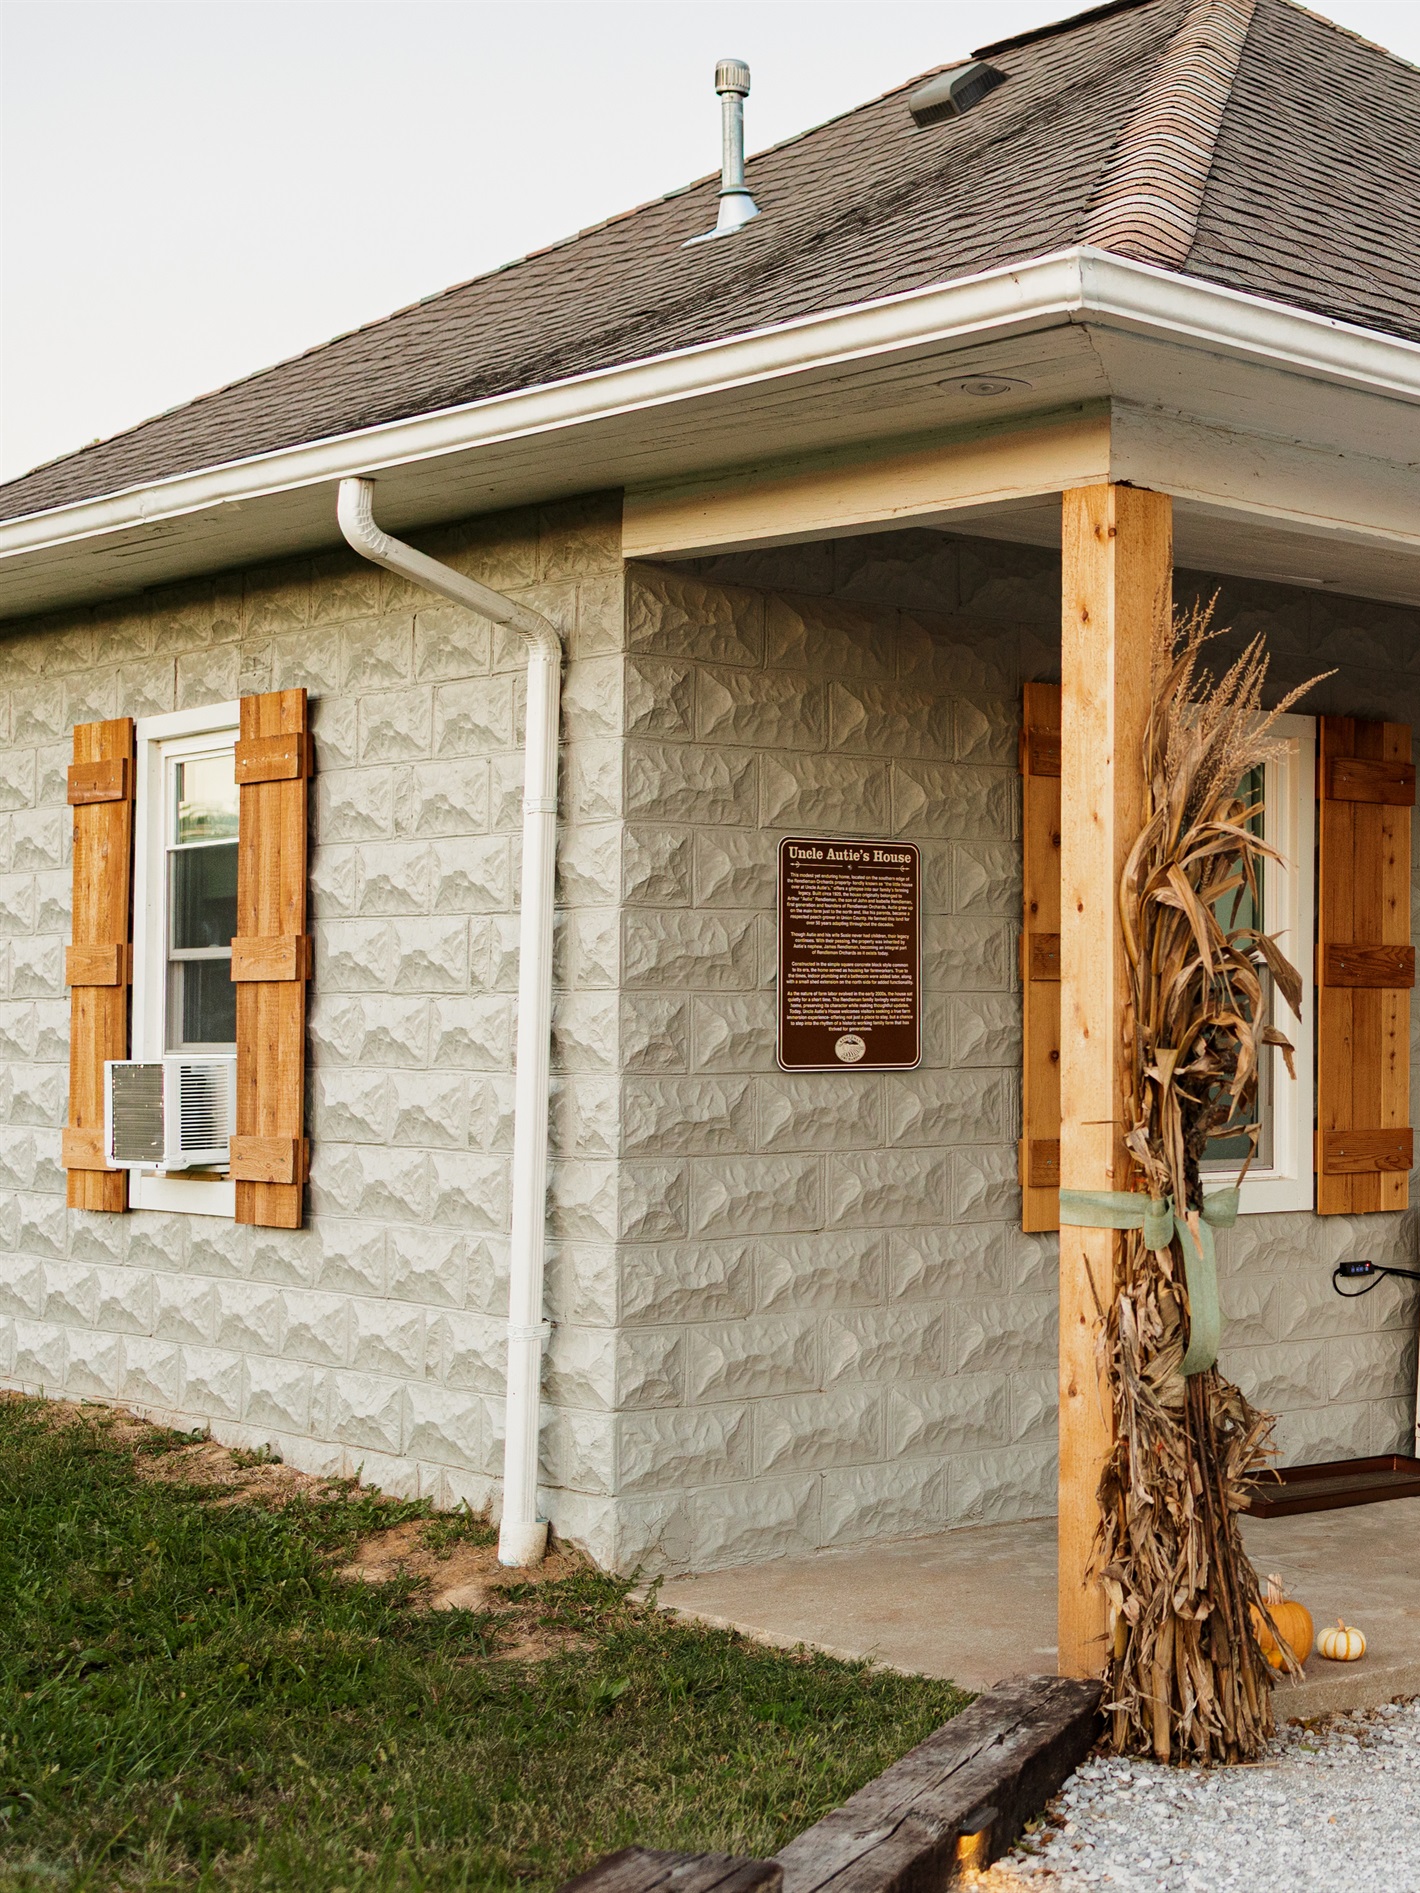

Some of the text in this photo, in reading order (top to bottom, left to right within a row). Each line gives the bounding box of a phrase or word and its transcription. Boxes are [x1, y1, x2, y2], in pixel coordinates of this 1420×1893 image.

[789, 846, 912, 863] Uncle Autie's House
